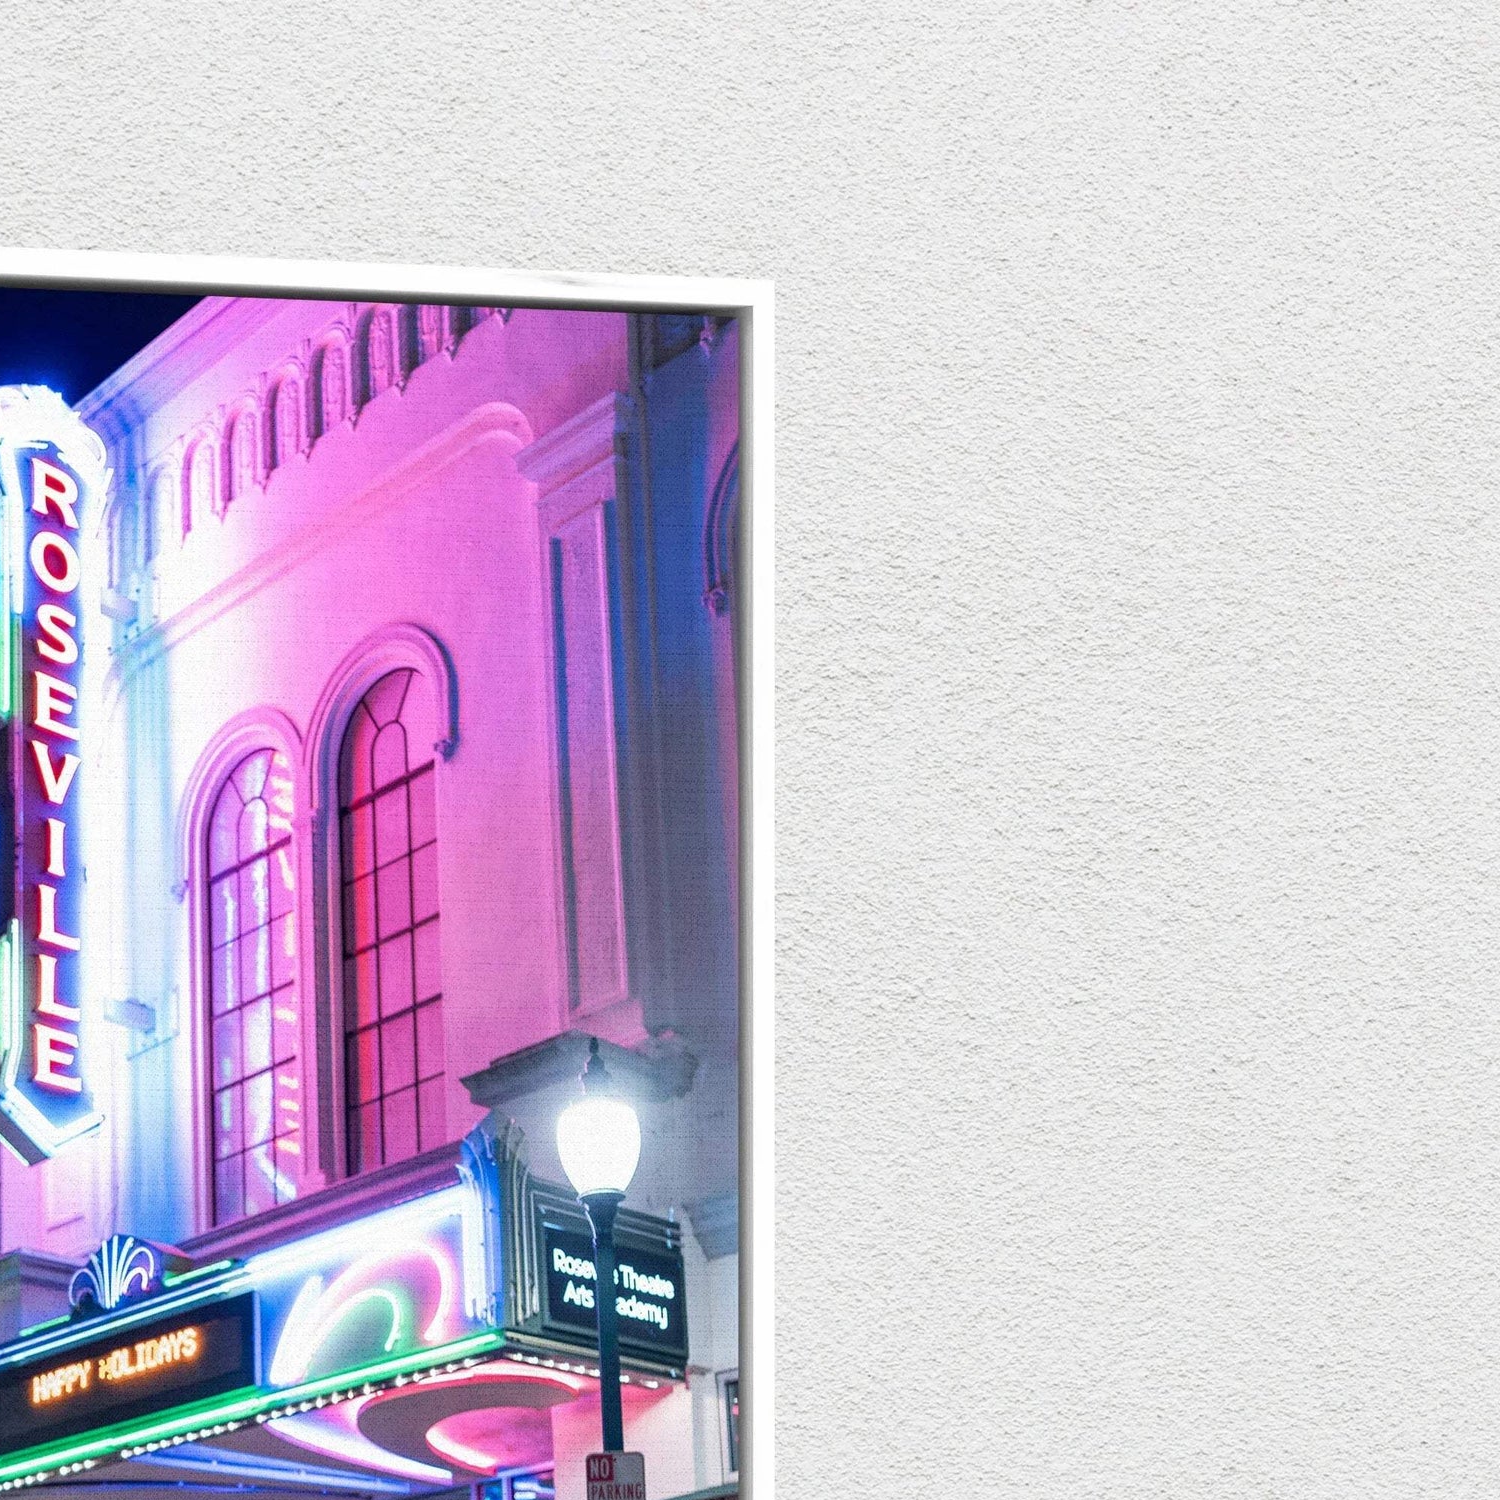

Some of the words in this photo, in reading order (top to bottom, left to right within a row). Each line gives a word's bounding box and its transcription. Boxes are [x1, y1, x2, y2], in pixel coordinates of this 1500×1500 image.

[30, 456, 82, 1092] ROSEVILLE
[563, 1279, 595, 1309] Arts
[619, 1264, 675, 1300] Theatre
[32, 1360, 92, 1404] HAPPY
[588, 1457, 611, 1479] NO
[590, 1482, 643, 1500] PARKING
